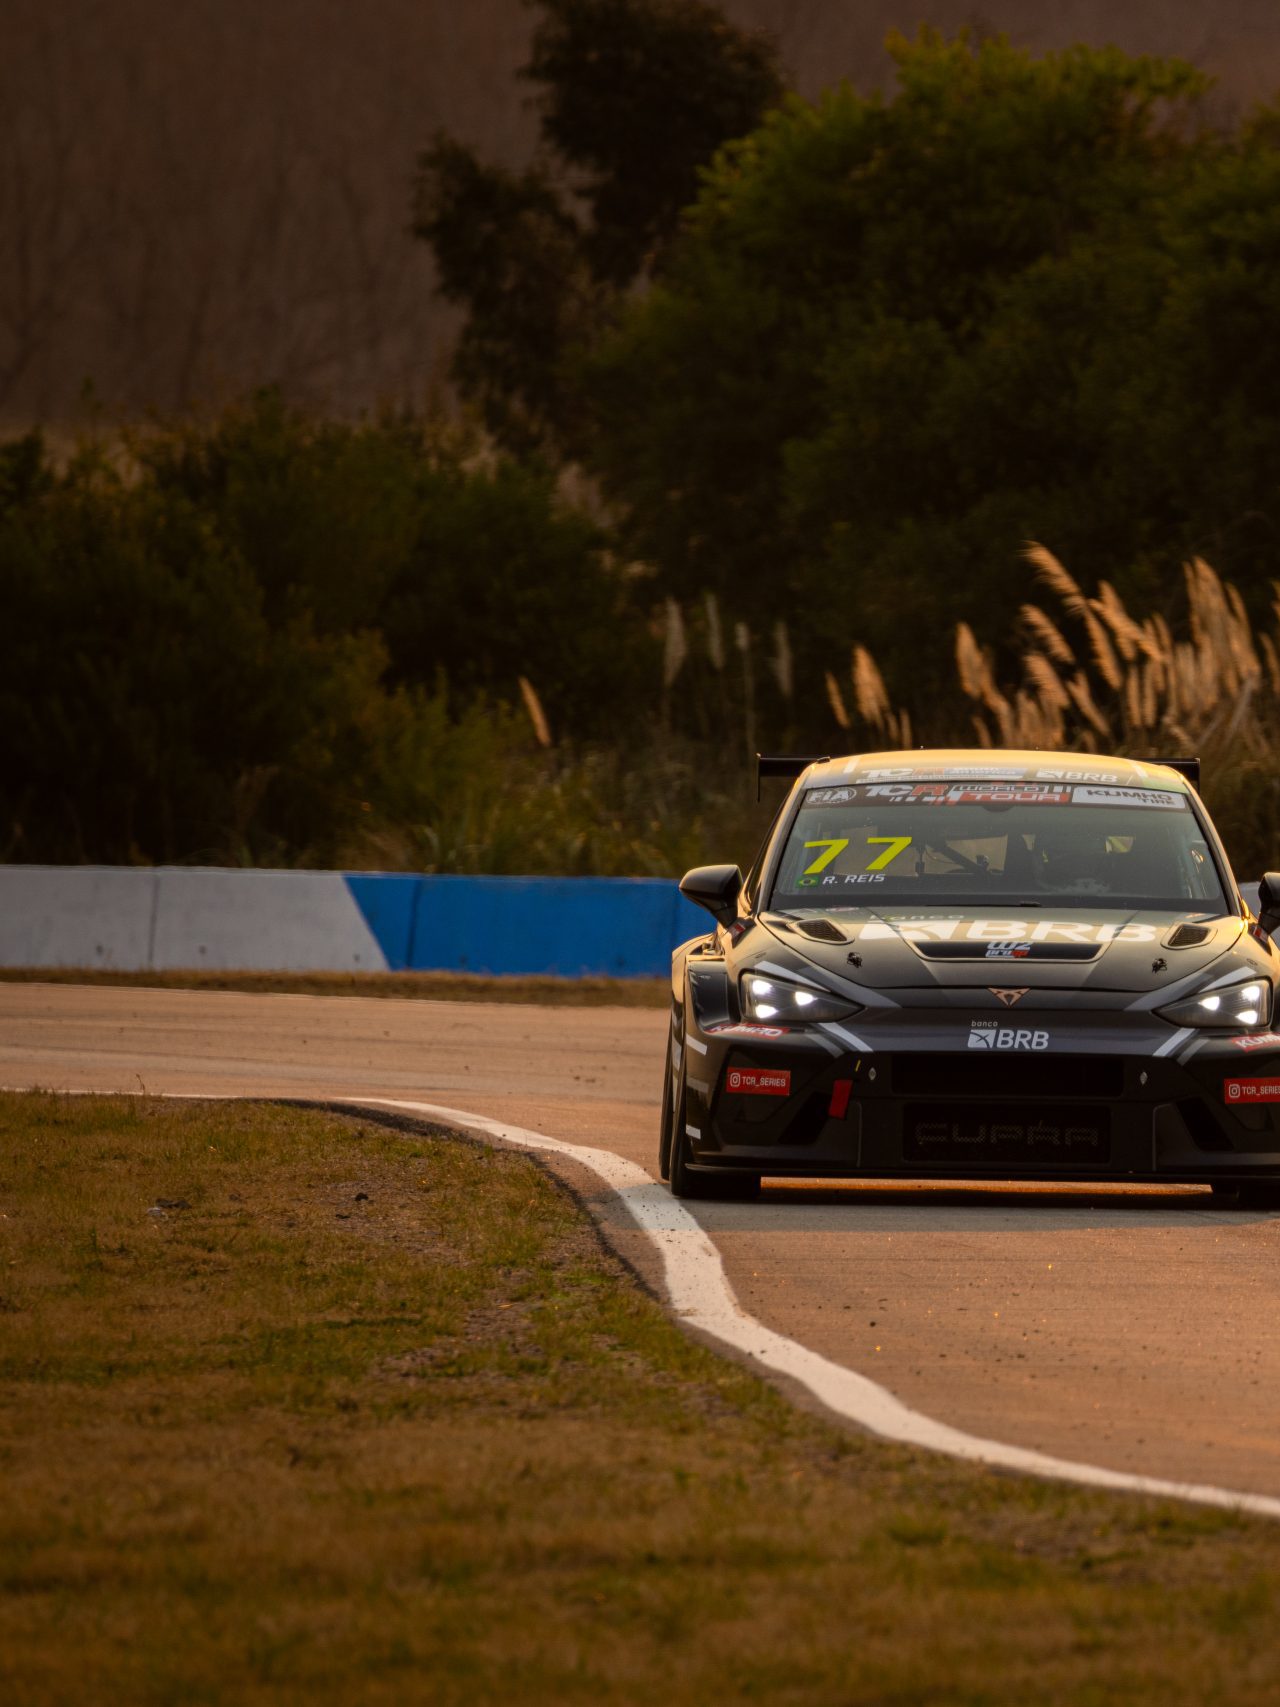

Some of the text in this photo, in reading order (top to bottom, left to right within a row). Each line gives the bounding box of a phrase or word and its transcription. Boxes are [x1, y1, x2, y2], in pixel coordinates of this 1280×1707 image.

[1065, 771, 1119, 783] BRB
[808, 788, 850, 802] FIA
[865, 785, 949, 797] TCR
[969, 793, 1060, 801] TOUR
[1087, 790, 1173, 801] KUMHO
[822, 873, 887, 885] R. REIS
[966, 920, 1157, 942] BRB
[996, 1029, 1050, 1050] BRB
[742, 1076, 786, 1087] TCR_SERIES
[915, 1122, 1100, 1146] CUPRA
